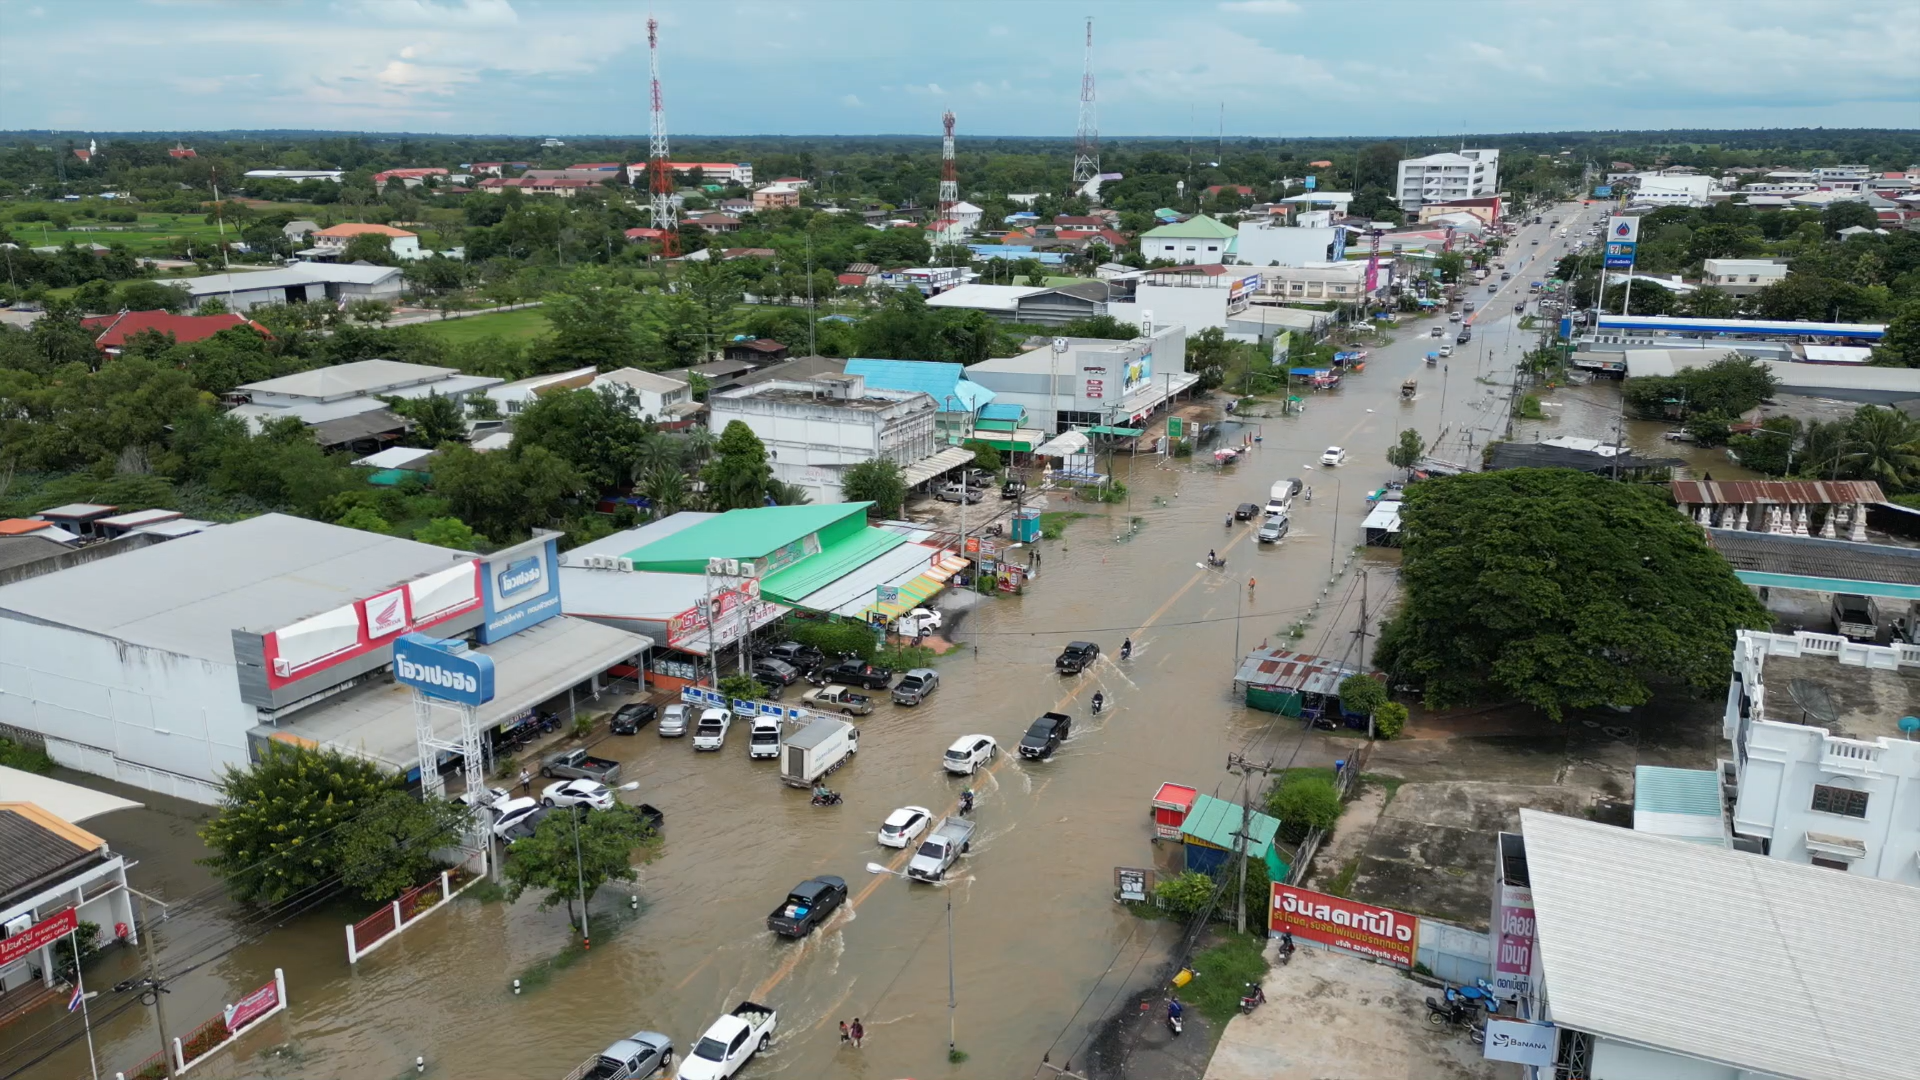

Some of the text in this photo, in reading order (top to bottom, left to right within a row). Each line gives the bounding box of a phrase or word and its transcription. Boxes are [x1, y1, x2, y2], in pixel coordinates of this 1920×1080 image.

[503, 567, 540, 591] โอวเปงฮง
[395, 653, 477, 693] โอวเปงฮง
[1273, 892, 1412, 942] เงินสดทันใจ
[1501, 908, 1534, 937] ปล่อย
[1, 930, 33, 954] ไปรษณีย์
[41, 933, 53, 943] POST
[1501, 939, 1531, 973] เงินกู้
